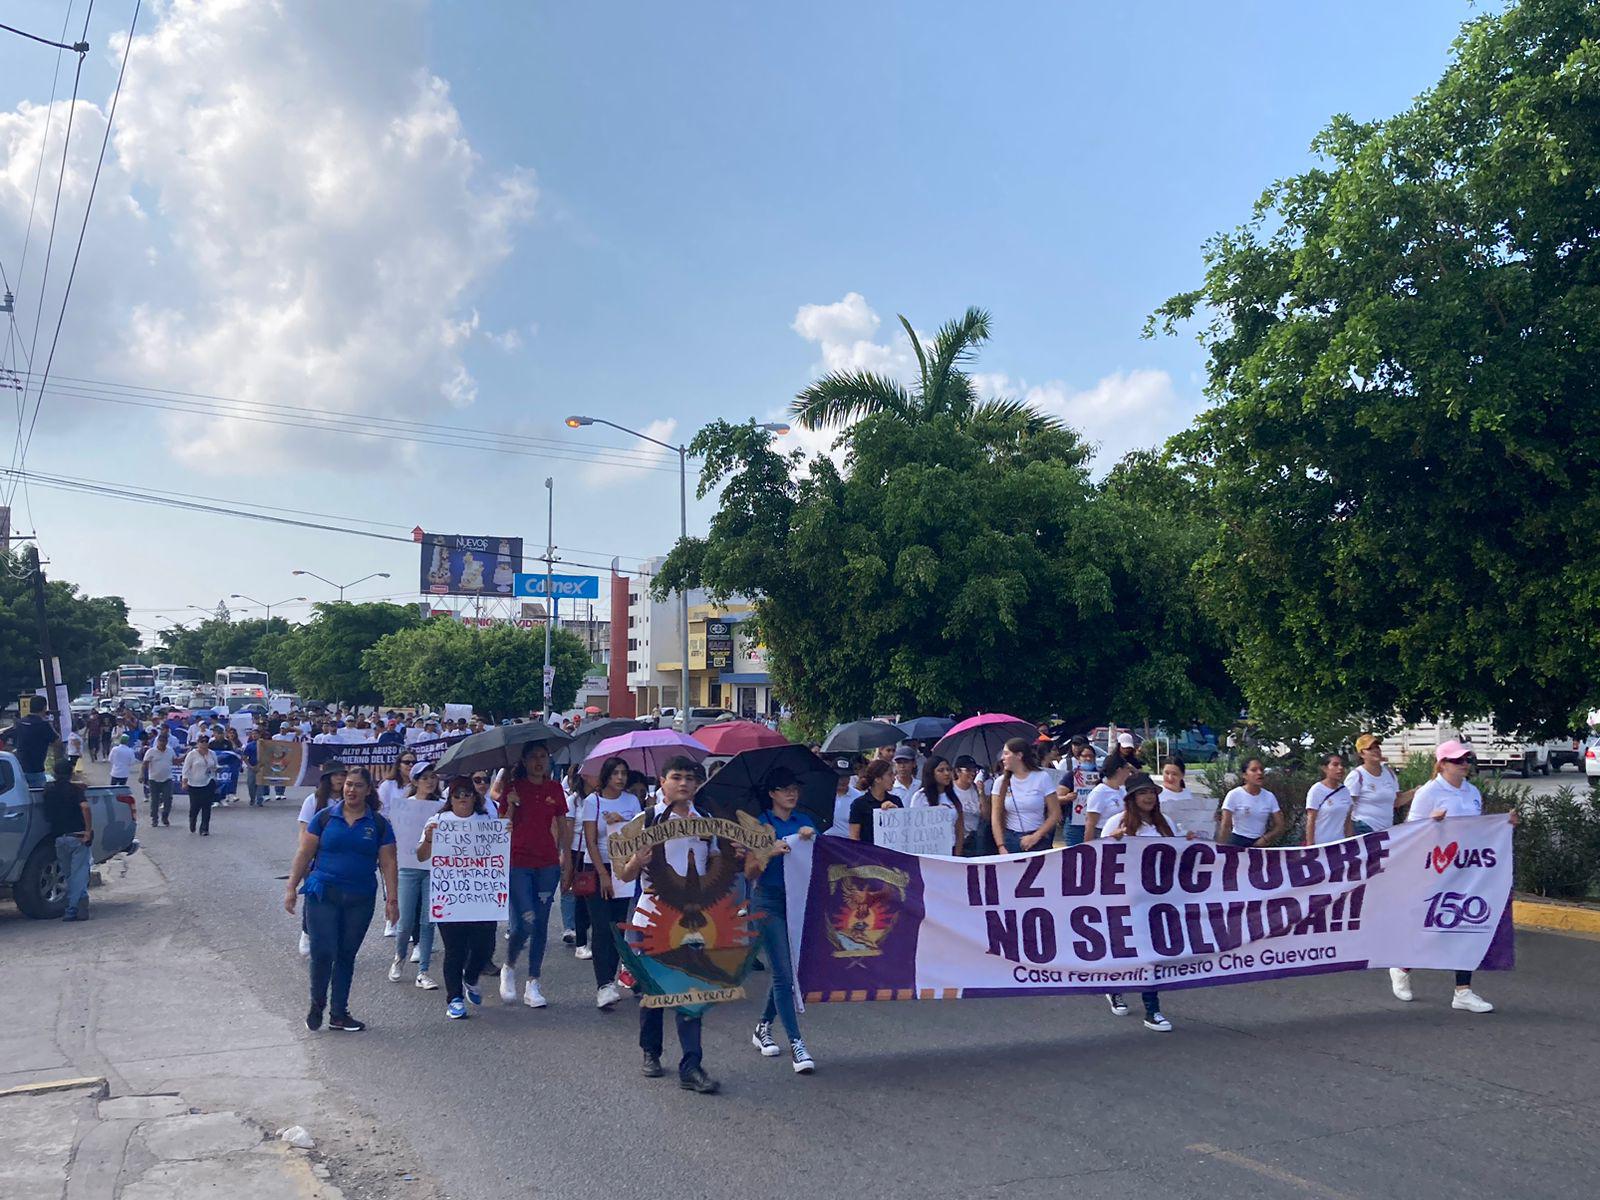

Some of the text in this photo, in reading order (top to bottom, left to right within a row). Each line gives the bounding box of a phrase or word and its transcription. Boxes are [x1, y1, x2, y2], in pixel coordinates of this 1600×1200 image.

[456, 537, 488, 548] NUEVOS
[525, 578, 588, 594] Comex
[361, 747, 370, 755] AL
[372, 746, 397, 755] ABUSO
[371, 755, 385, 764] DEL
[439, 820, 459, 832] QUE
[435, 832, 509, 845] DE LAS MADRES
[452, 844, 491, 856] DE LOS
[432, 855, 504, 868] ESTUDIANTES
[1062, 843, 1127, 896] DE
[1141, 831, 1390, 895] OCTUBRE
[1454, 848, 1497, 869] UAS
[432, 880, 450, 892] NO
[474, 881, 507, 892] DEJEN
[1424, 892, 1491, 928] 150
[985, 883, 1366, 964] NO SE OLVIDA!!
[1013, 946, 1337, 983] Casa Femenil: Ernesto Che Guevara
